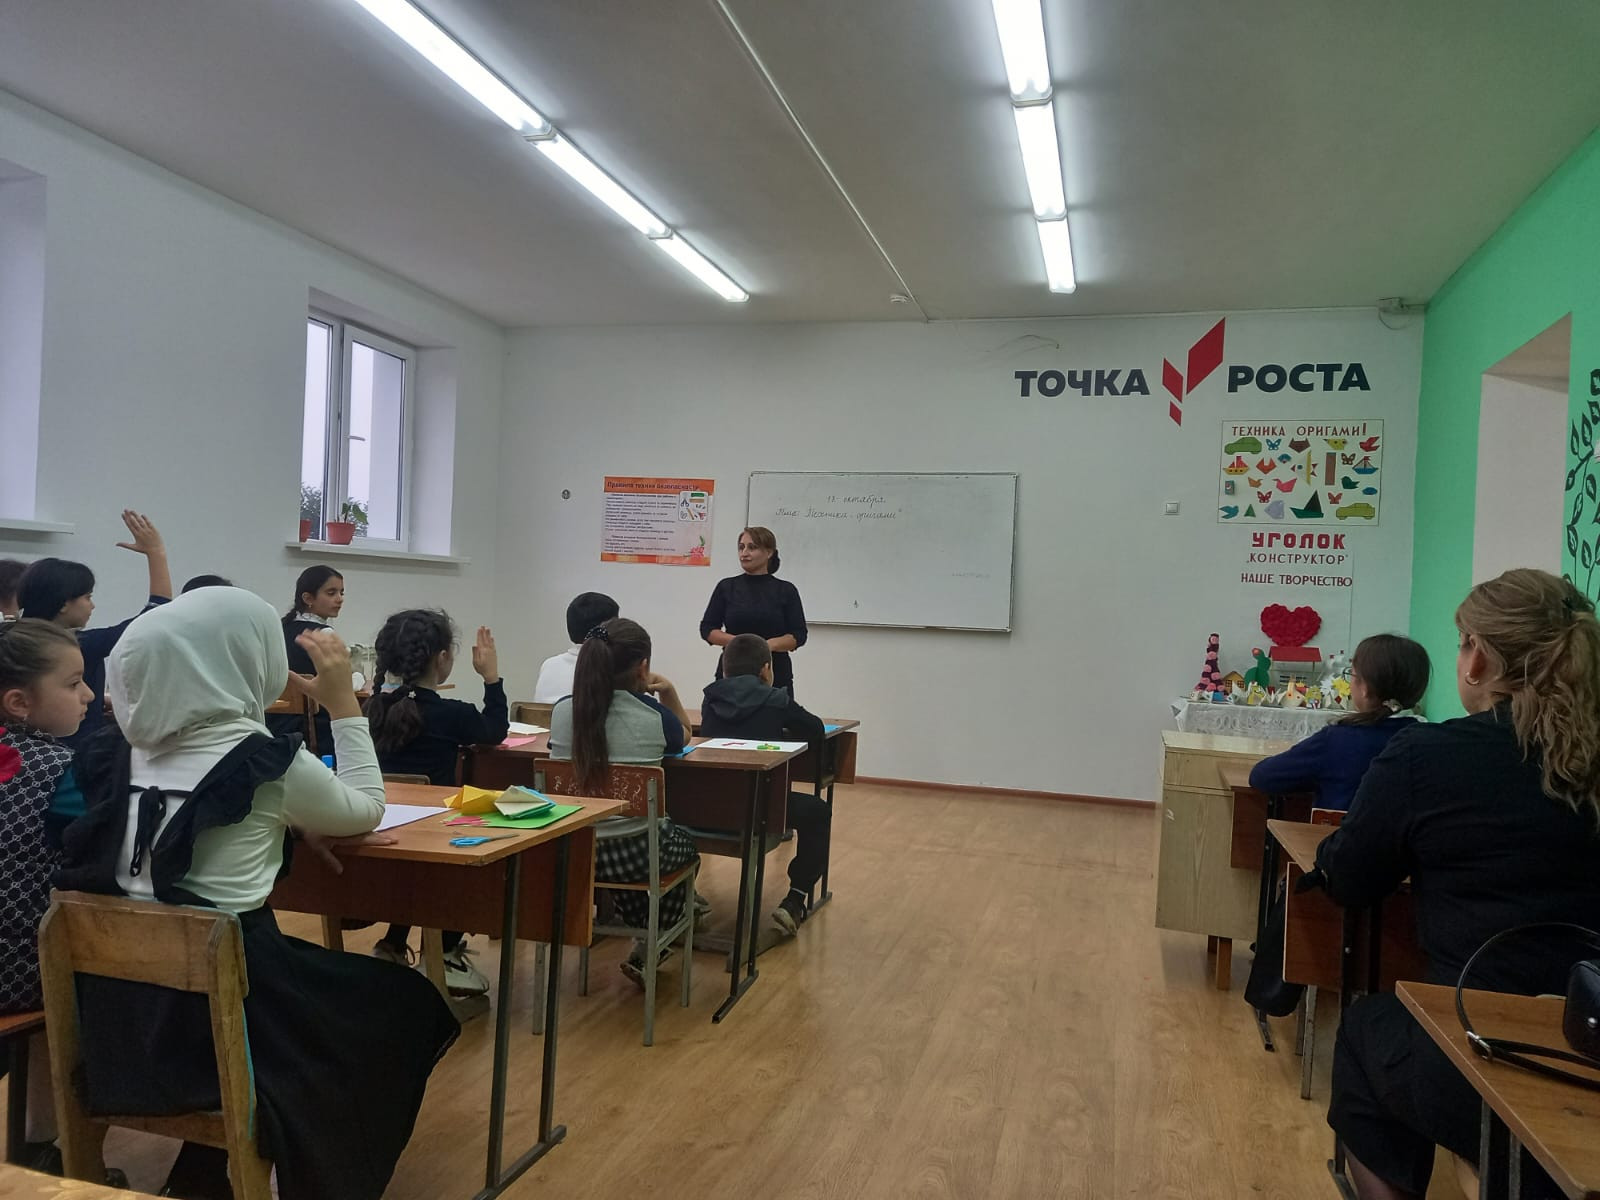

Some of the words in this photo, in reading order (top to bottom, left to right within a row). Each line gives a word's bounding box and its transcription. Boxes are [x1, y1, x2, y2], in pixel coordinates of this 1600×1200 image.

[1014, 368, 1150, 397] ТОЧКА
[1227, 363, 1371, 393] РОСТА
[1232, 425, 1286, 437] ТЕХНИКА
[1296, 422, 1367, 437] ОРИГАМИ!
[1252, 532, 1346, 550] УГОЛОК
[1241, 573, 1274, 584] НАШЕ
[1279, 575, 1353, 587] ТВОРЧЕСТВО
